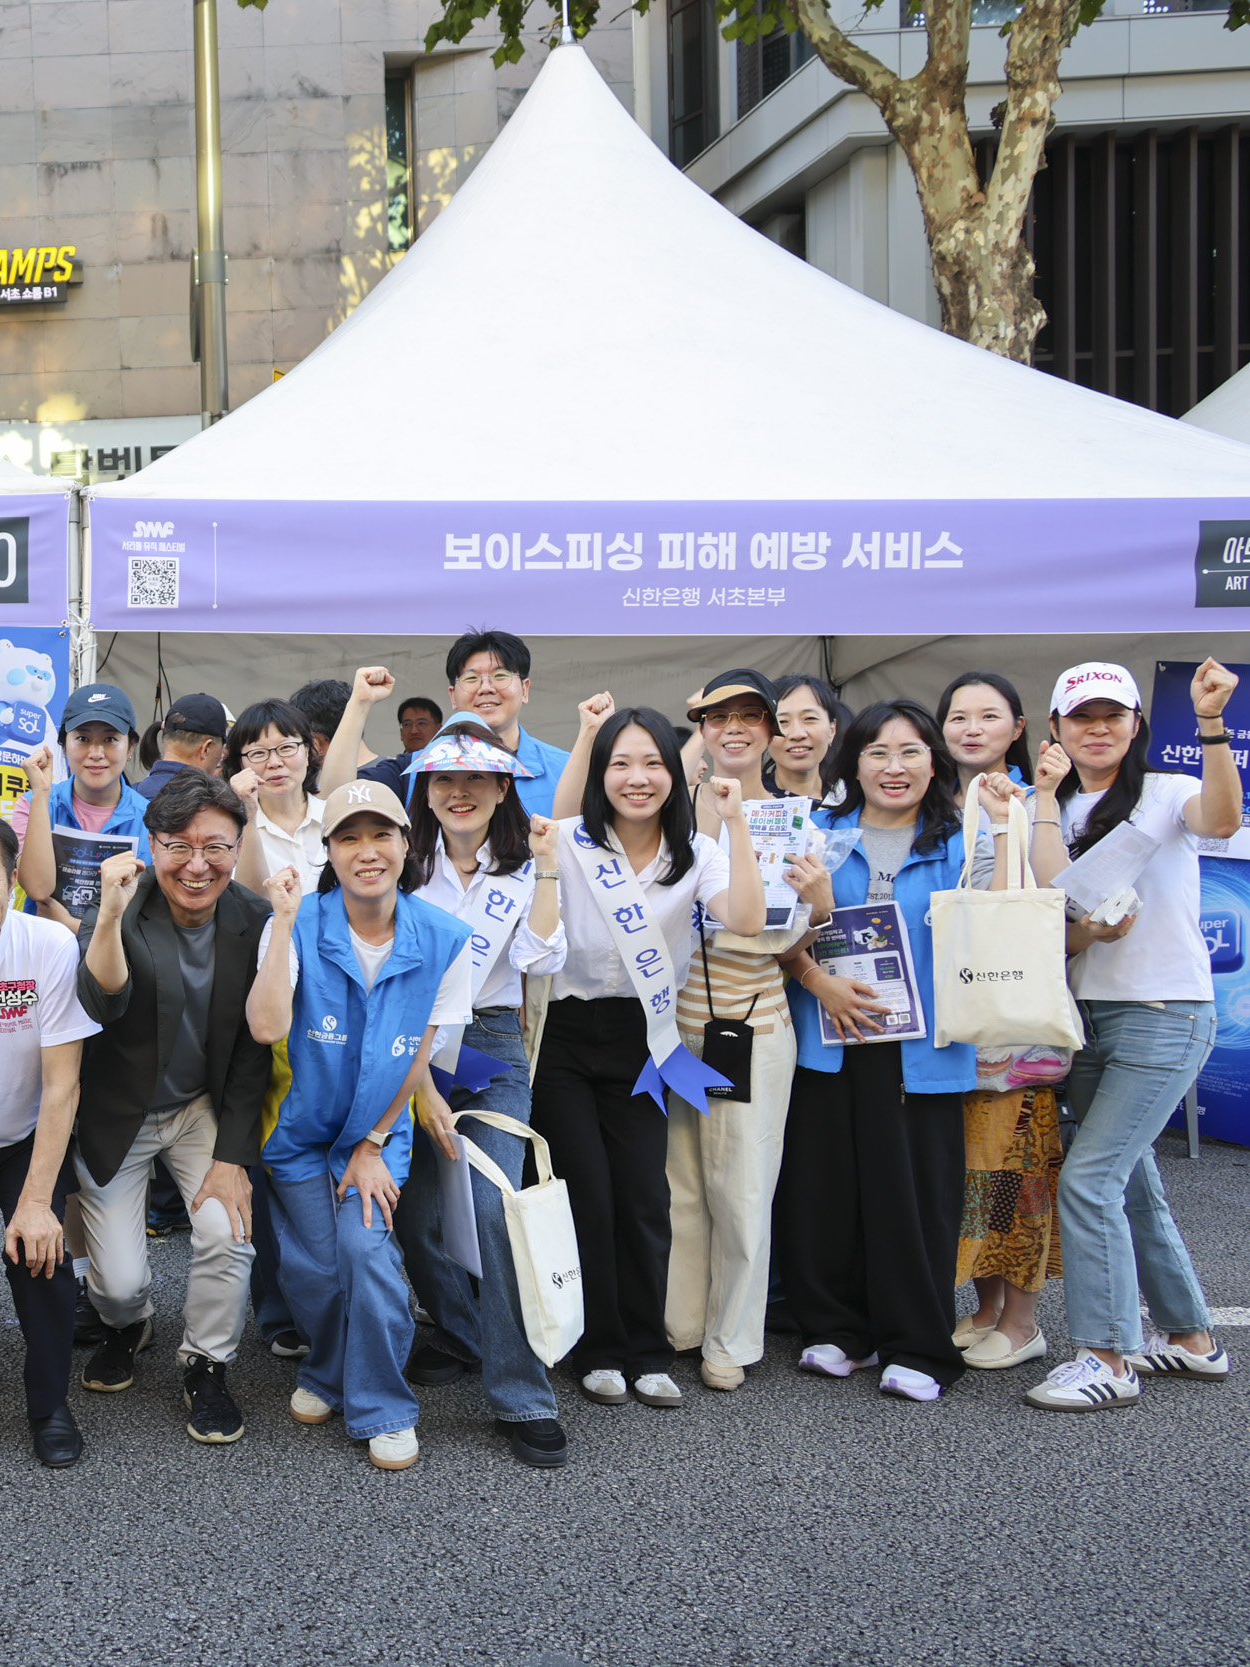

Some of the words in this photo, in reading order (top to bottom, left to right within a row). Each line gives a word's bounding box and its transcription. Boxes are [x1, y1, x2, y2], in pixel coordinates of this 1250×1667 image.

[0, 287, 21, 301] 서초
[43, 286, 57, 298] B1
[443, 532, 643, 571] 보이스피싱
[658, 532, 737, 571] 피해
[750, 531, 831, 570] 예방
[842, 531, 964, 570] 서비스
[1225, 575, 1249, 591] ART
[622, 587, 700, 607] 신한은행
[707, 587, 786, 607] 서초본부
[1065, 671, 1123, 690] SRIXON
[19, 708, 42, 720] super
[17, 717, 41, 734] SOL
[1230, 749, 1249, 769] 퍼
[347, 784, 372, 805] NY
[595, 858, 671, 1016] 신한은행
[1203, 930, 1230, 955] OL
[976, 970, 1024, 982] 신한은행
